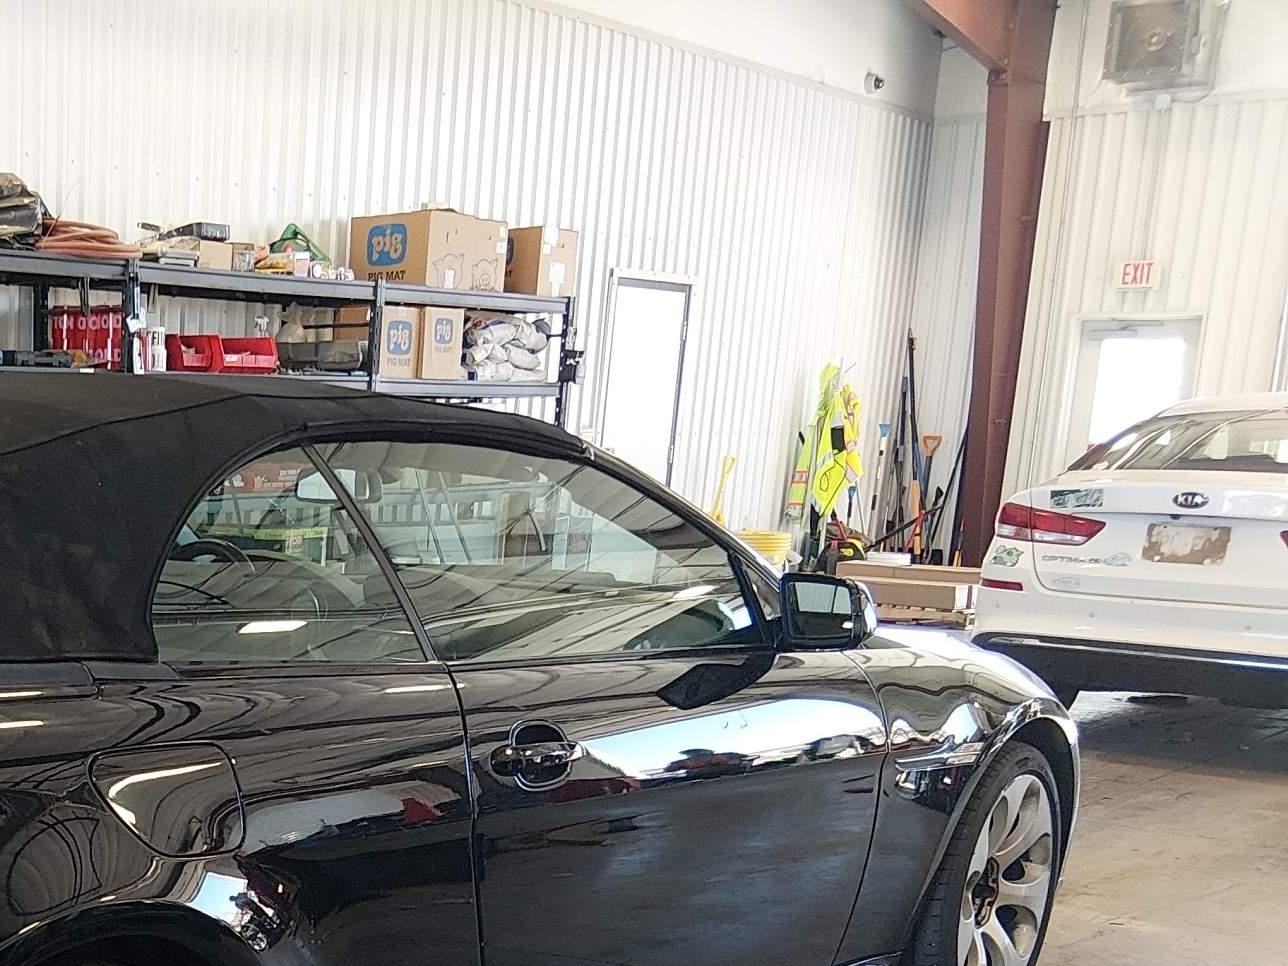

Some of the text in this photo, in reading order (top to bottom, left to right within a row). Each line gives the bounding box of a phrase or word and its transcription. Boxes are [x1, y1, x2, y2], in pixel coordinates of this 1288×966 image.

[371, 229, 403, 261] pig
[368, 270, 406, 281] PIG MAT
[1121, 261, 1154, 286] EXIT
[389, 325, 411, 354] pig
[436, 320, 452, 342] pig
[386, 357, 412, 367] PIG MAT
[1175, 493, 1208, 507] KIA
